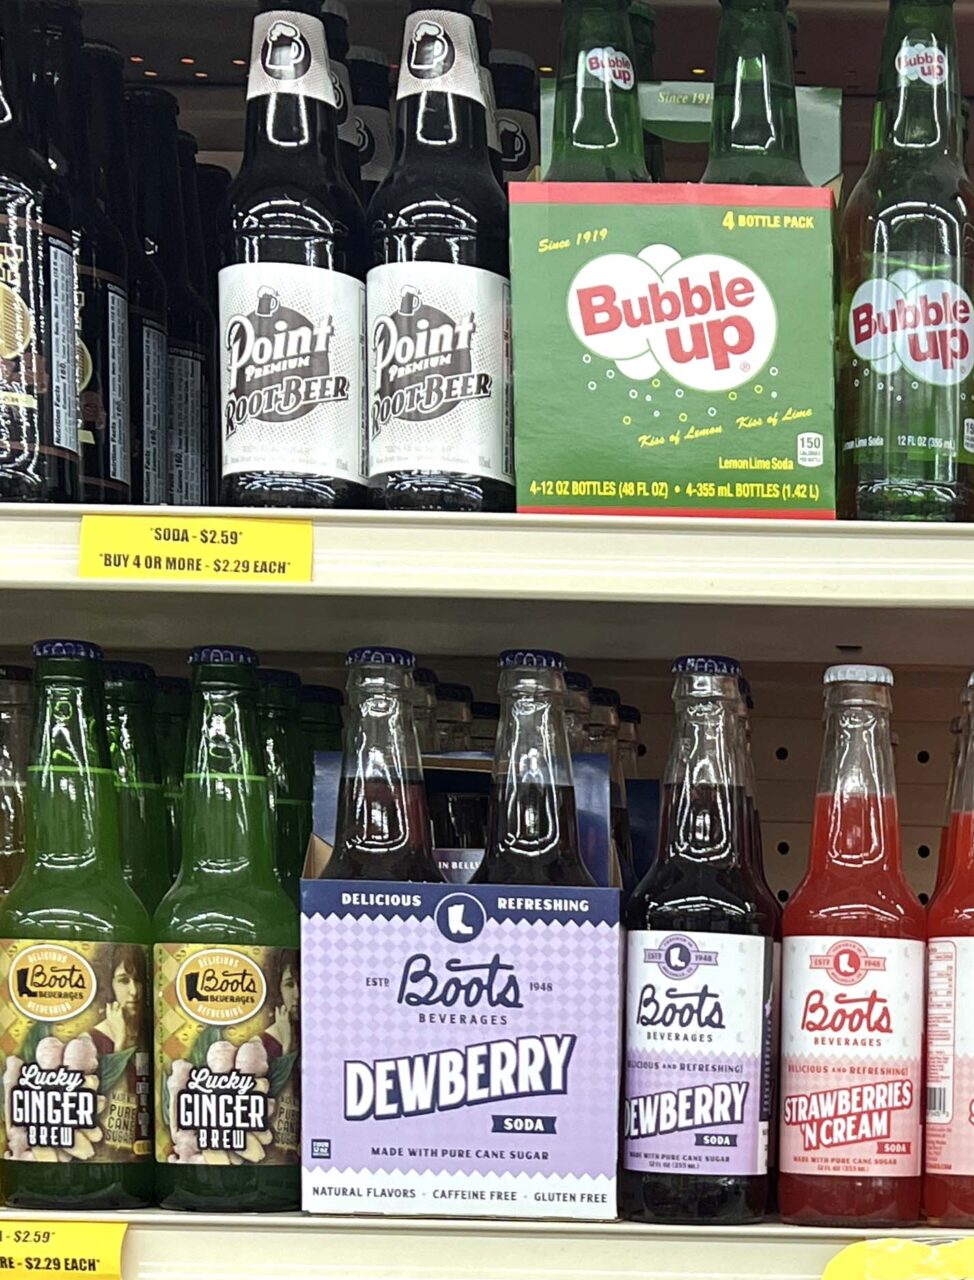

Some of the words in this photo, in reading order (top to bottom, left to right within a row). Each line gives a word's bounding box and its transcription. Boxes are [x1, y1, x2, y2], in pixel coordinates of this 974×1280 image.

[722, 211, 735, 230] 4
[738, 215, 781, 228] BOTTLE
[784, 216, 814, 229] PACK
[539, 237, 570, 253] Since
[576, 229, 608, 245] 1919
[576, 271, 755, 336] Bubble
[853, 294, 970, 345] Bubble
[226, 312, 335, 393] Point
[373, 312, 478, 393] Point
[665, 315, 755, 371] up
[909, 331, 970, 369] up
[735, 416, 762, 430] Kiss
[766, 412, 778, 426] of
[781, 407, 813, 422] Lime
[638, 435, 664, 448] Kiss
[669, 430, 682, 445] of
[684, 425, 723, 440] Lemon
[800, 438, 820, 450] 150
[719, 457, 749, 470] Lemon
[749, 458, 770, 470] Lime
[771, 458, 794, 470] Soda
[530, 481, 552, 495] 4-12
[555, 482, 570, 495] OZ
[572, 482, 616, 496] BOTTLES
[619, 482, 634, 497] (48
[637, 483, 649, 496] FL
[651, 482, 668, 499] OZ)
[686, 483, 715, 497] 4-355
[717, 484, 733, 497] mL
[735, 484, 780, 498] BOTTLES
[782, 484, 806, 500] (1.42
[808, 485, 820, 500] L)
[133, 555, 141, 569] 4
[145, 556, 161, 569] OR
[166, 557, 202, 571] MORE
[214, 559, 249, 573] $2.29
[341, 893, 422, 907] DELICIOUS
[497, 897, 589, 912] REFRESHING
[30, 964, 87, 990] Boots
[200, 968, 257, 993] Boots
[397, 953, 524, 1008] Boots
[637, 984, 725, 1029] Boots
[801, 990, 893, 1033] Boots
[419, 1013, 507, 1025] BEVERAGES
[647, 1032, 713, 1042] BEVERAGES
[814, 1037, 882, 1047] BEVERAGES
[18, 1064, 86, 1091] Lucky
[344, 1034, 576, 1121] DEWBERRY
[680, 1063, 743, 1073] REFRESHING!
[188, 1068, 257, 1094] Lucky
[13, 1090, 94, 1126] GINGER
[180, 1092, 265, 1128] GINGER
[784, 1079, 913, 1124] STRAWBERRIES
[28, 1125, 73, 1145] BREW
[504, 1118, 544, 1131] SODA
[818, 1110, 890, 1148] CREAM
[199, 1128, 245, 1149] BREW
[704, 1136, 730, 1146] SODA
[884, 1143, 907, 1152] SODA
[371, 1147, 404, 1156] MADE
[407, 1147, 438, 1157] WITH
[442, 1148, 472, 1158] PURE
[475, 1149, 505, 1159] CANE
[510, 1150, 549, 1160] SUGAR
[313, 1186, 363, 1197] NATURAL
[367, 1187, 416, 1198] FLAVORS
[433, 1189, 486, 1200] CAFFEINE
[490, 1190, 517, 1201] FREE
[534, 1192, 577, 1202] GLUTEN
[581, 1193, 607, 1203] FREE
[25, 1257, 61, 1271] $2.29
